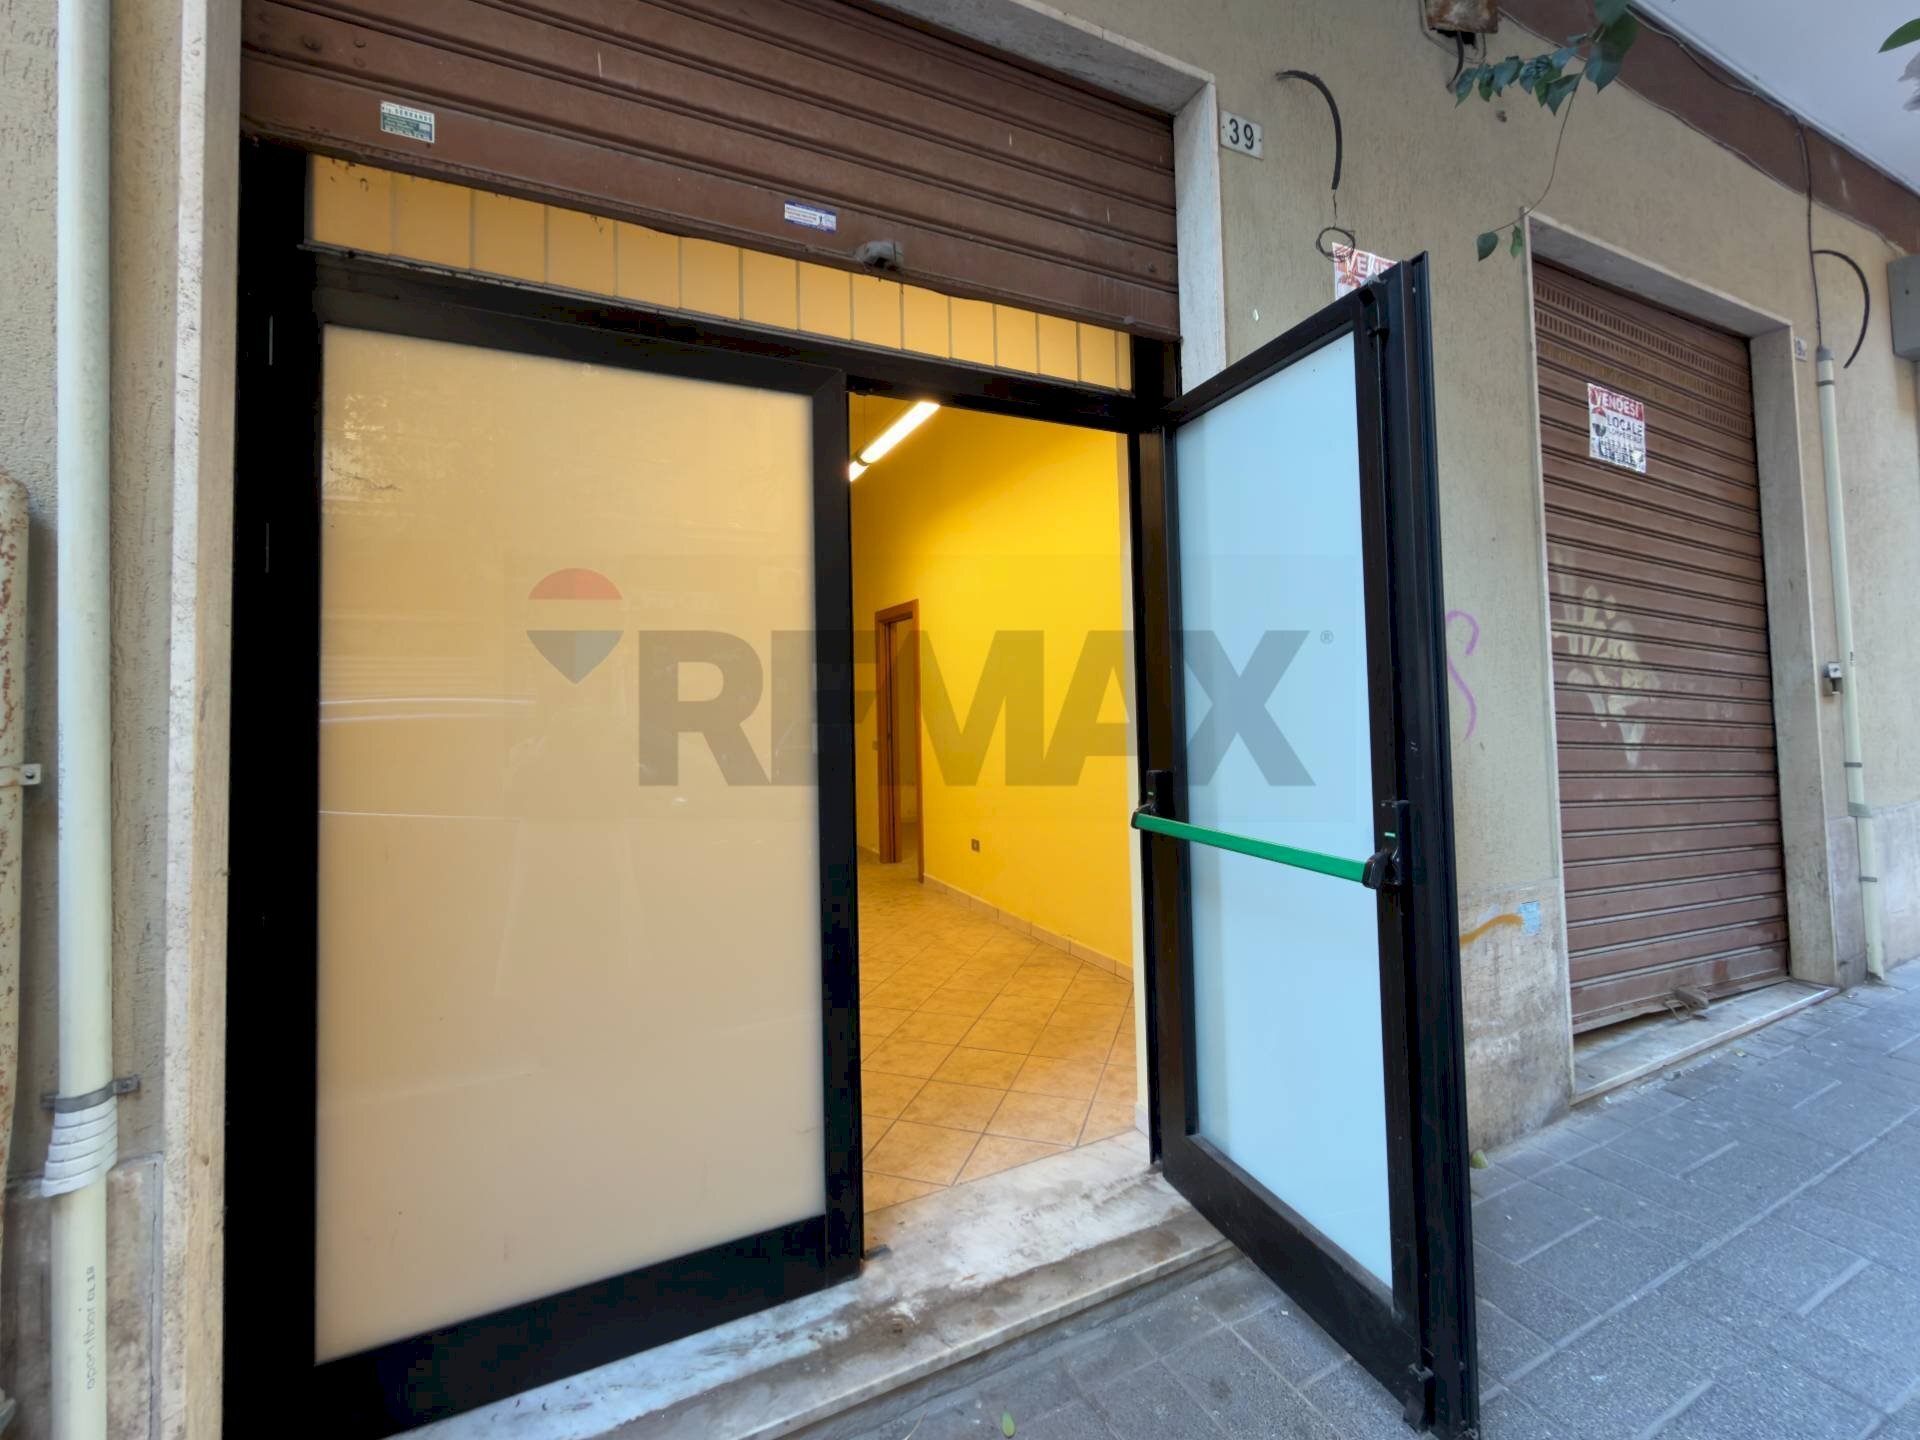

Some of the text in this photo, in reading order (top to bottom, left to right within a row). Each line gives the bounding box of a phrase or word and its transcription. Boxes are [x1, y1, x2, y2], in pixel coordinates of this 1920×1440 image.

[1229, 118, 1254, 150] 39
[1593, 389, 1640, 417] VENDESI
[1606, 416, 1643, 437] LOCALE
